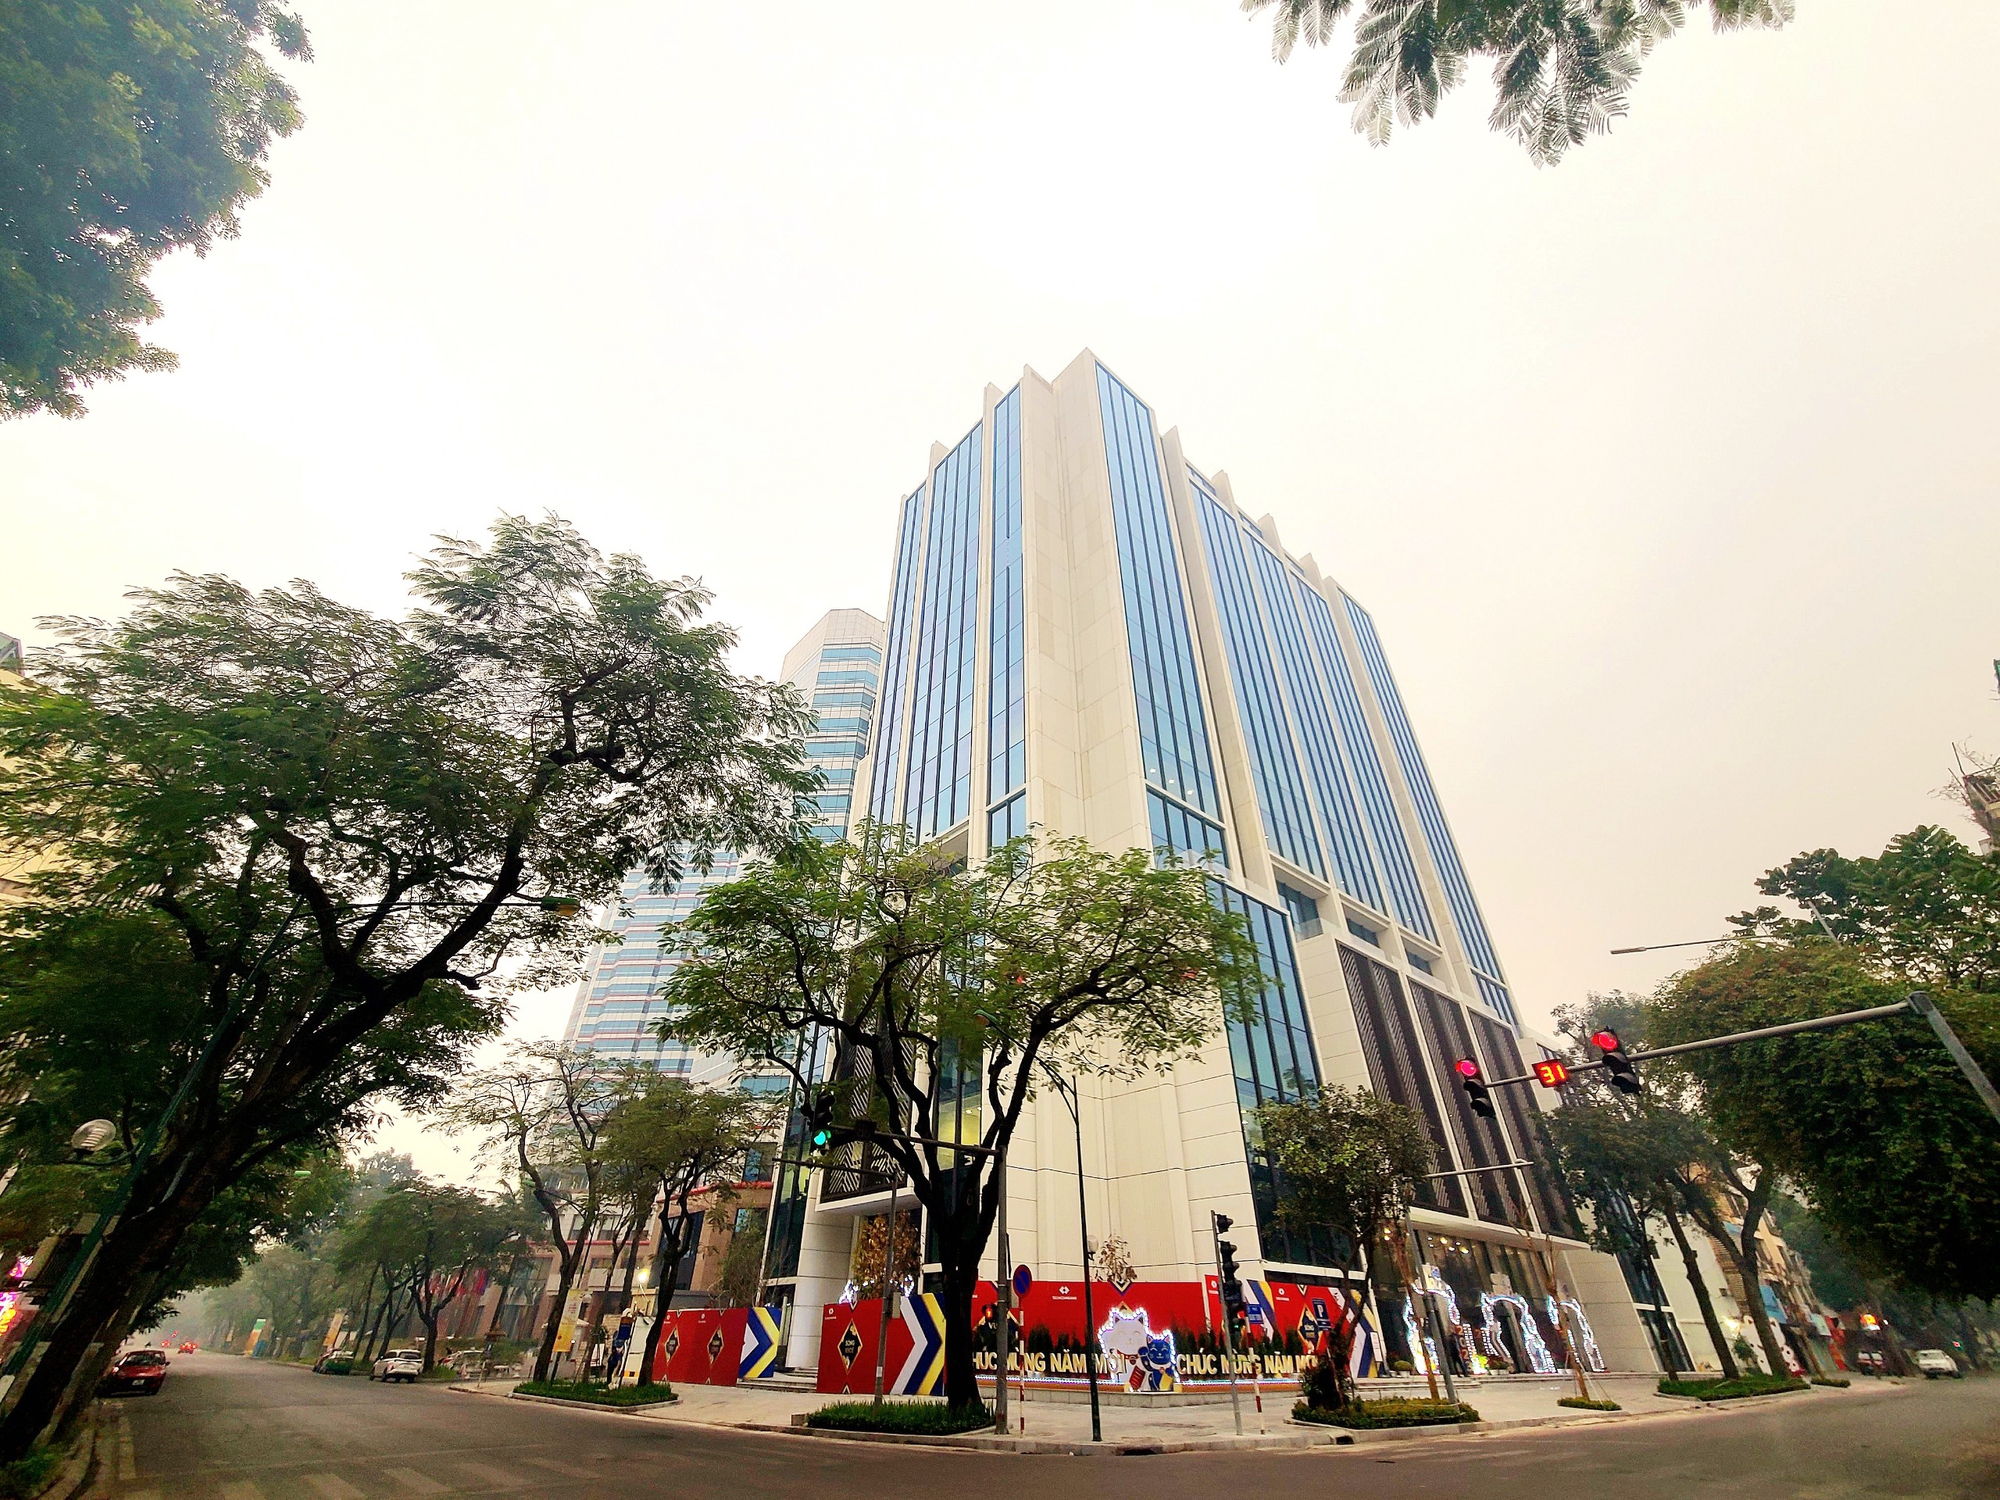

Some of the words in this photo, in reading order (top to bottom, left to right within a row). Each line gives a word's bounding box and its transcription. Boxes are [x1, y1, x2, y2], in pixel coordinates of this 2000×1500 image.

[1541, 1064, 1565, 1084] 31
[1317, 1304, 1324, 1318] P
[972, 1345, 998, 1370] HÚC
[1049, 1348, 1087, 1374] NĂM
[1176, 1347, 1218, 1375] CHÚC
